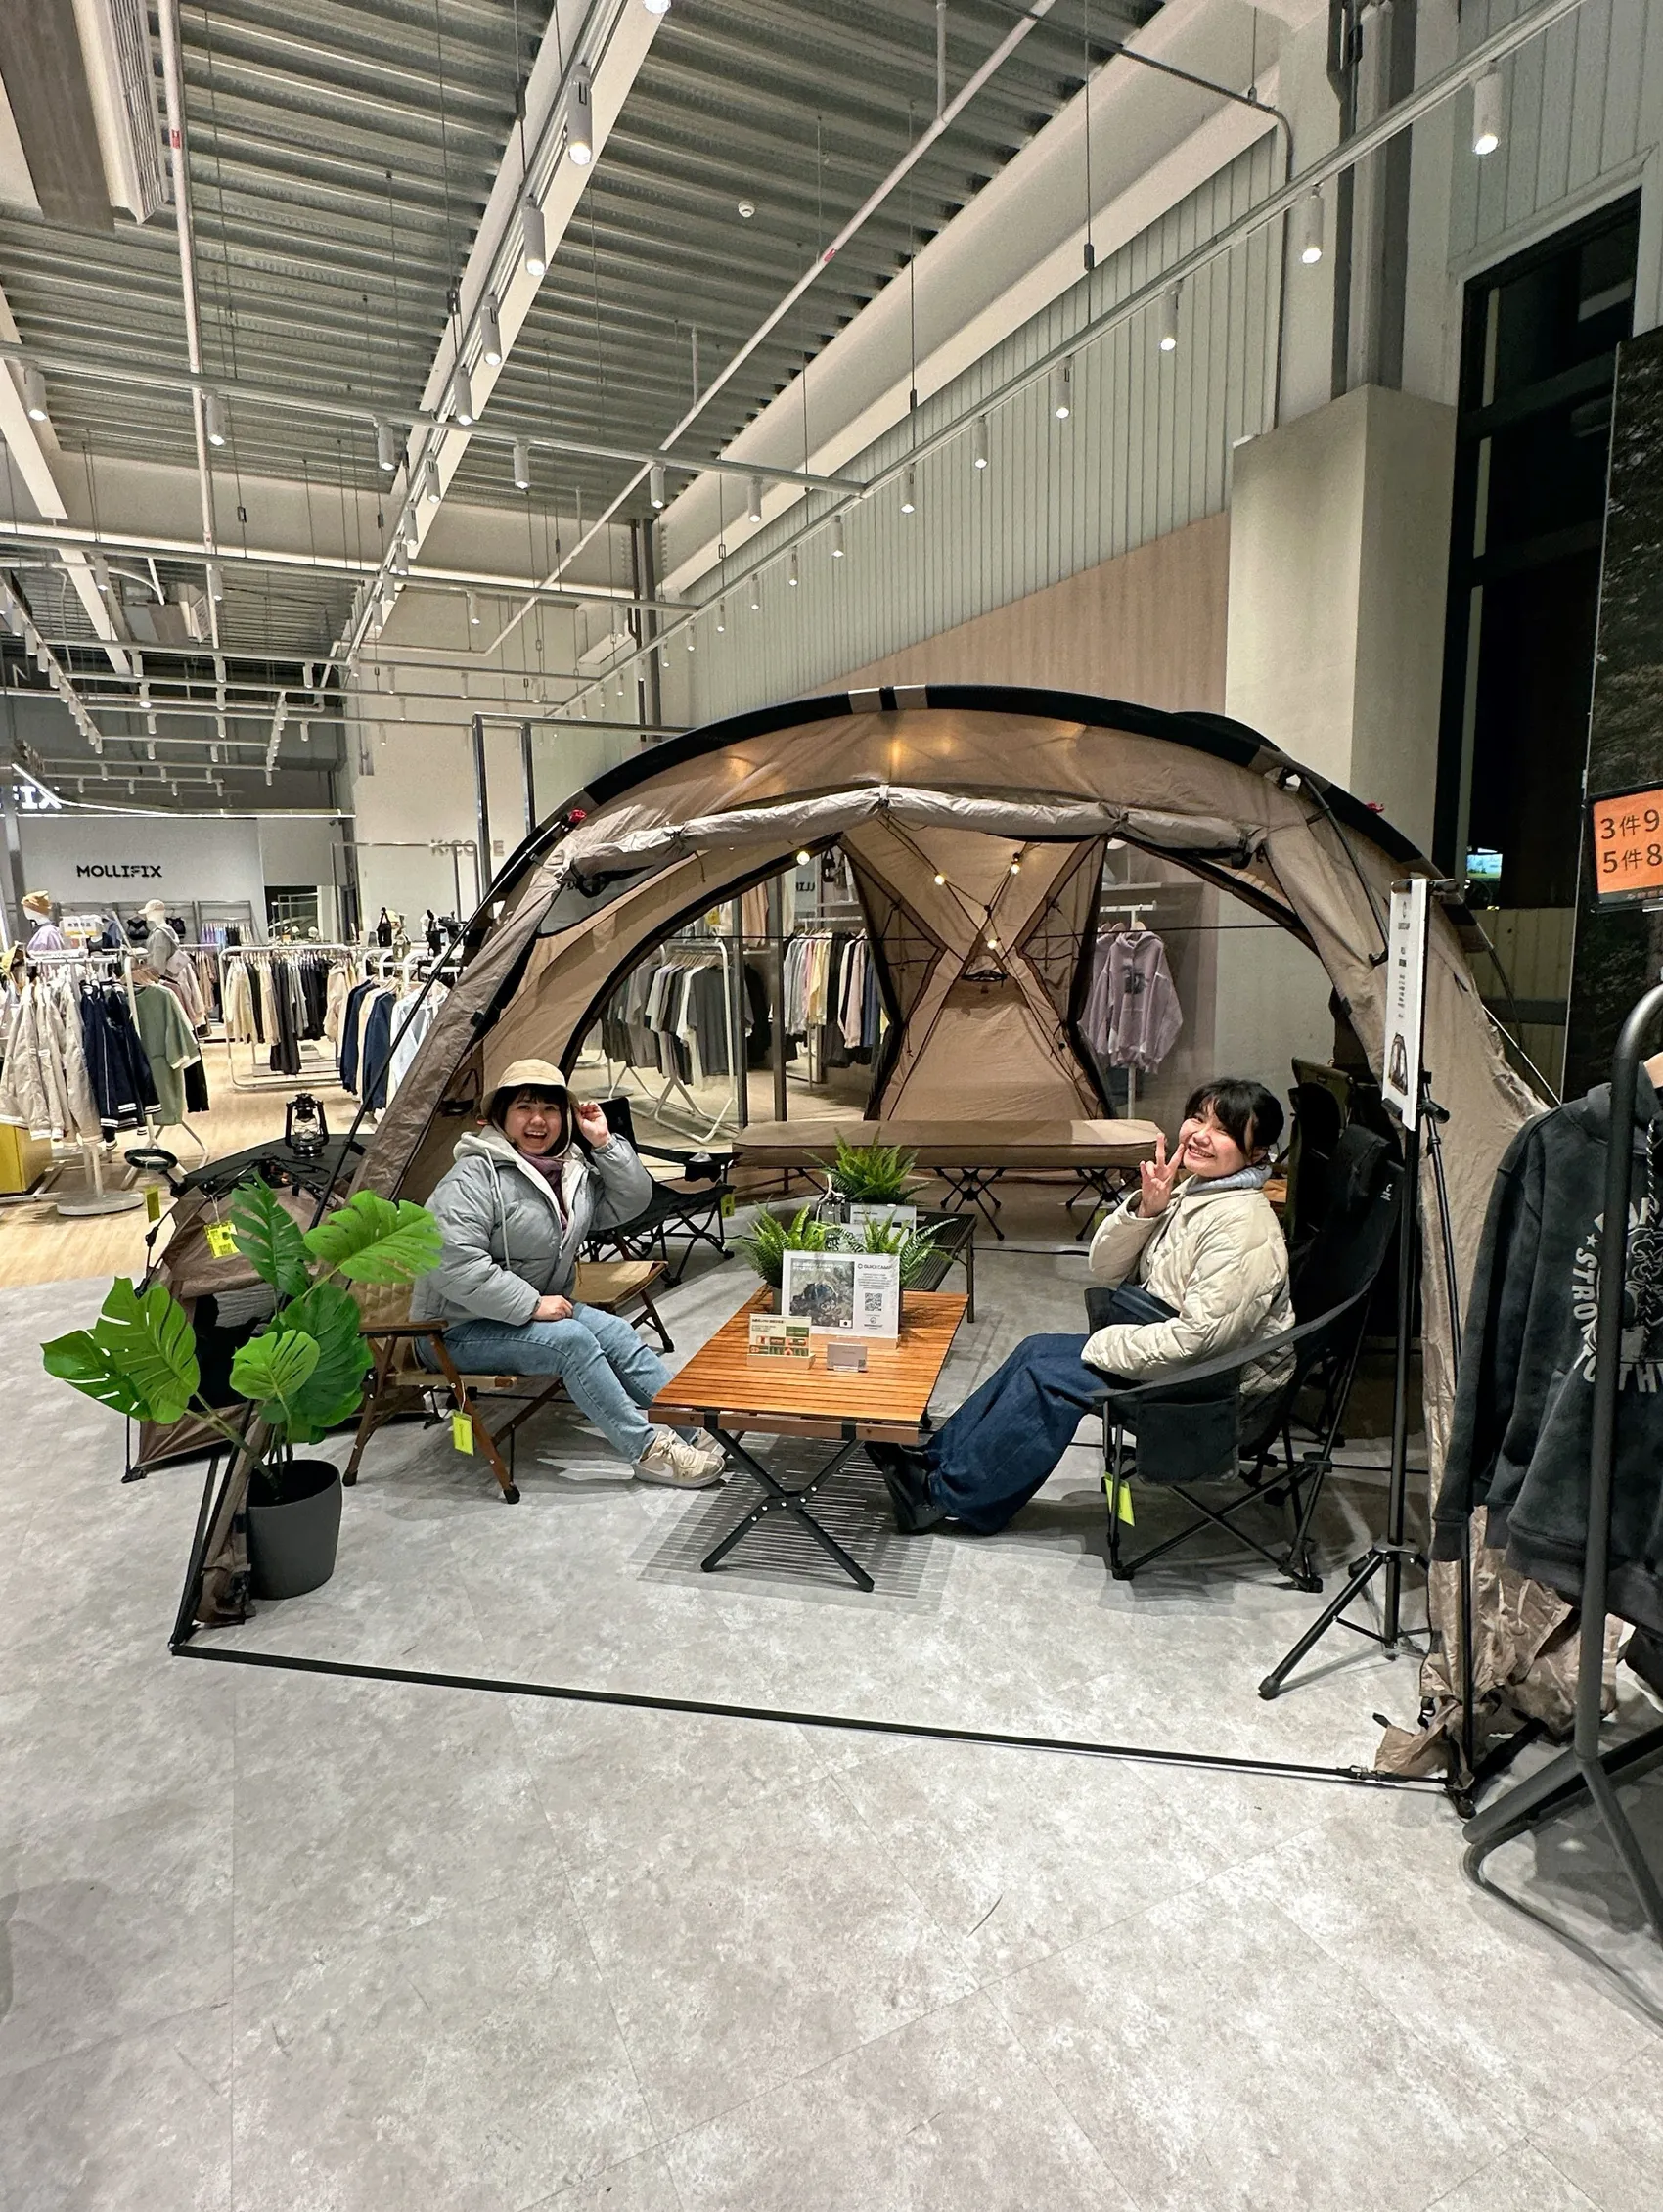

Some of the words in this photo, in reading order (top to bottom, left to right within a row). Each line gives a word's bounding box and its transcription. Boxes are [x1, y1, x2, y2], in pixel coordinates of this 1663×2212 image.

[1600, 809, 1660, 840] 3件9
[76, 865, 162, 878] MOLLIFIX
[1603, 843, 1663, 873] 5件8
